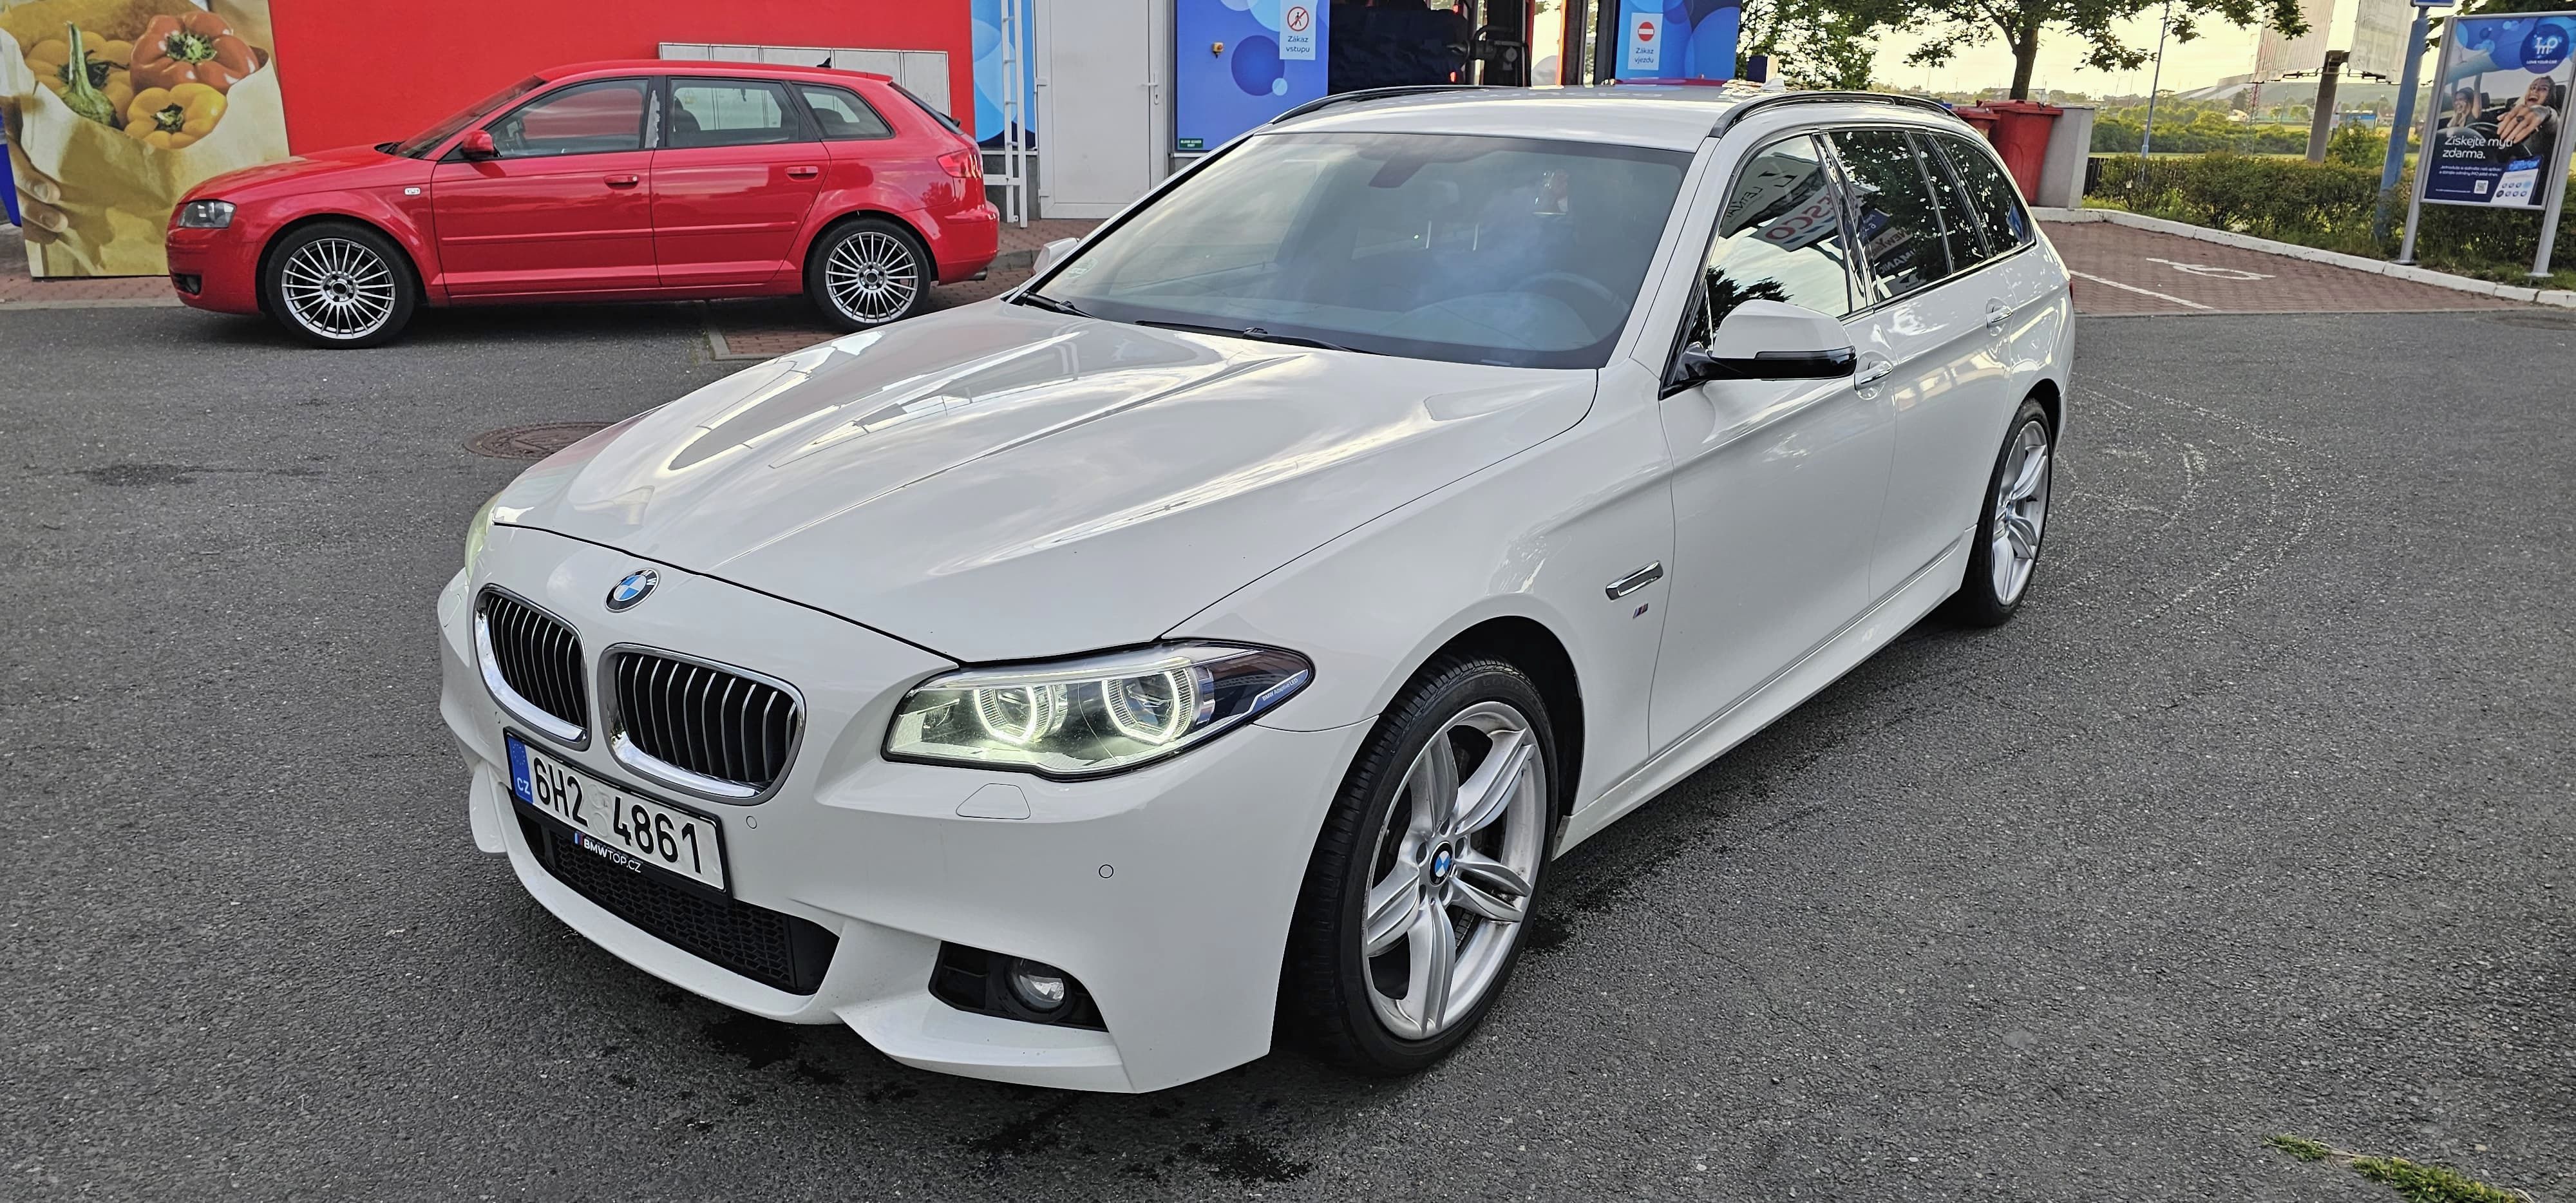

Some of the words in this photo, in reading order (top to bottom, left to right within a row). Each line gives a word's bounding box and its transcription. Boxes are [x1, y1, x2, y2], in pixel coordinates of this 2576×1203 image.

[1634, 57, 1654, 65] vjezdu
[2445, 135, 2486, 149] Získejte
[2441, 147, 2486, 159] zdarma.
[516, 777, 531, 795] CZ
[533, 757, 589, 828] 6H2
[612, 795, 703, 875] 4861
[583, 838, 641, 873] BMWTOP.CZ
